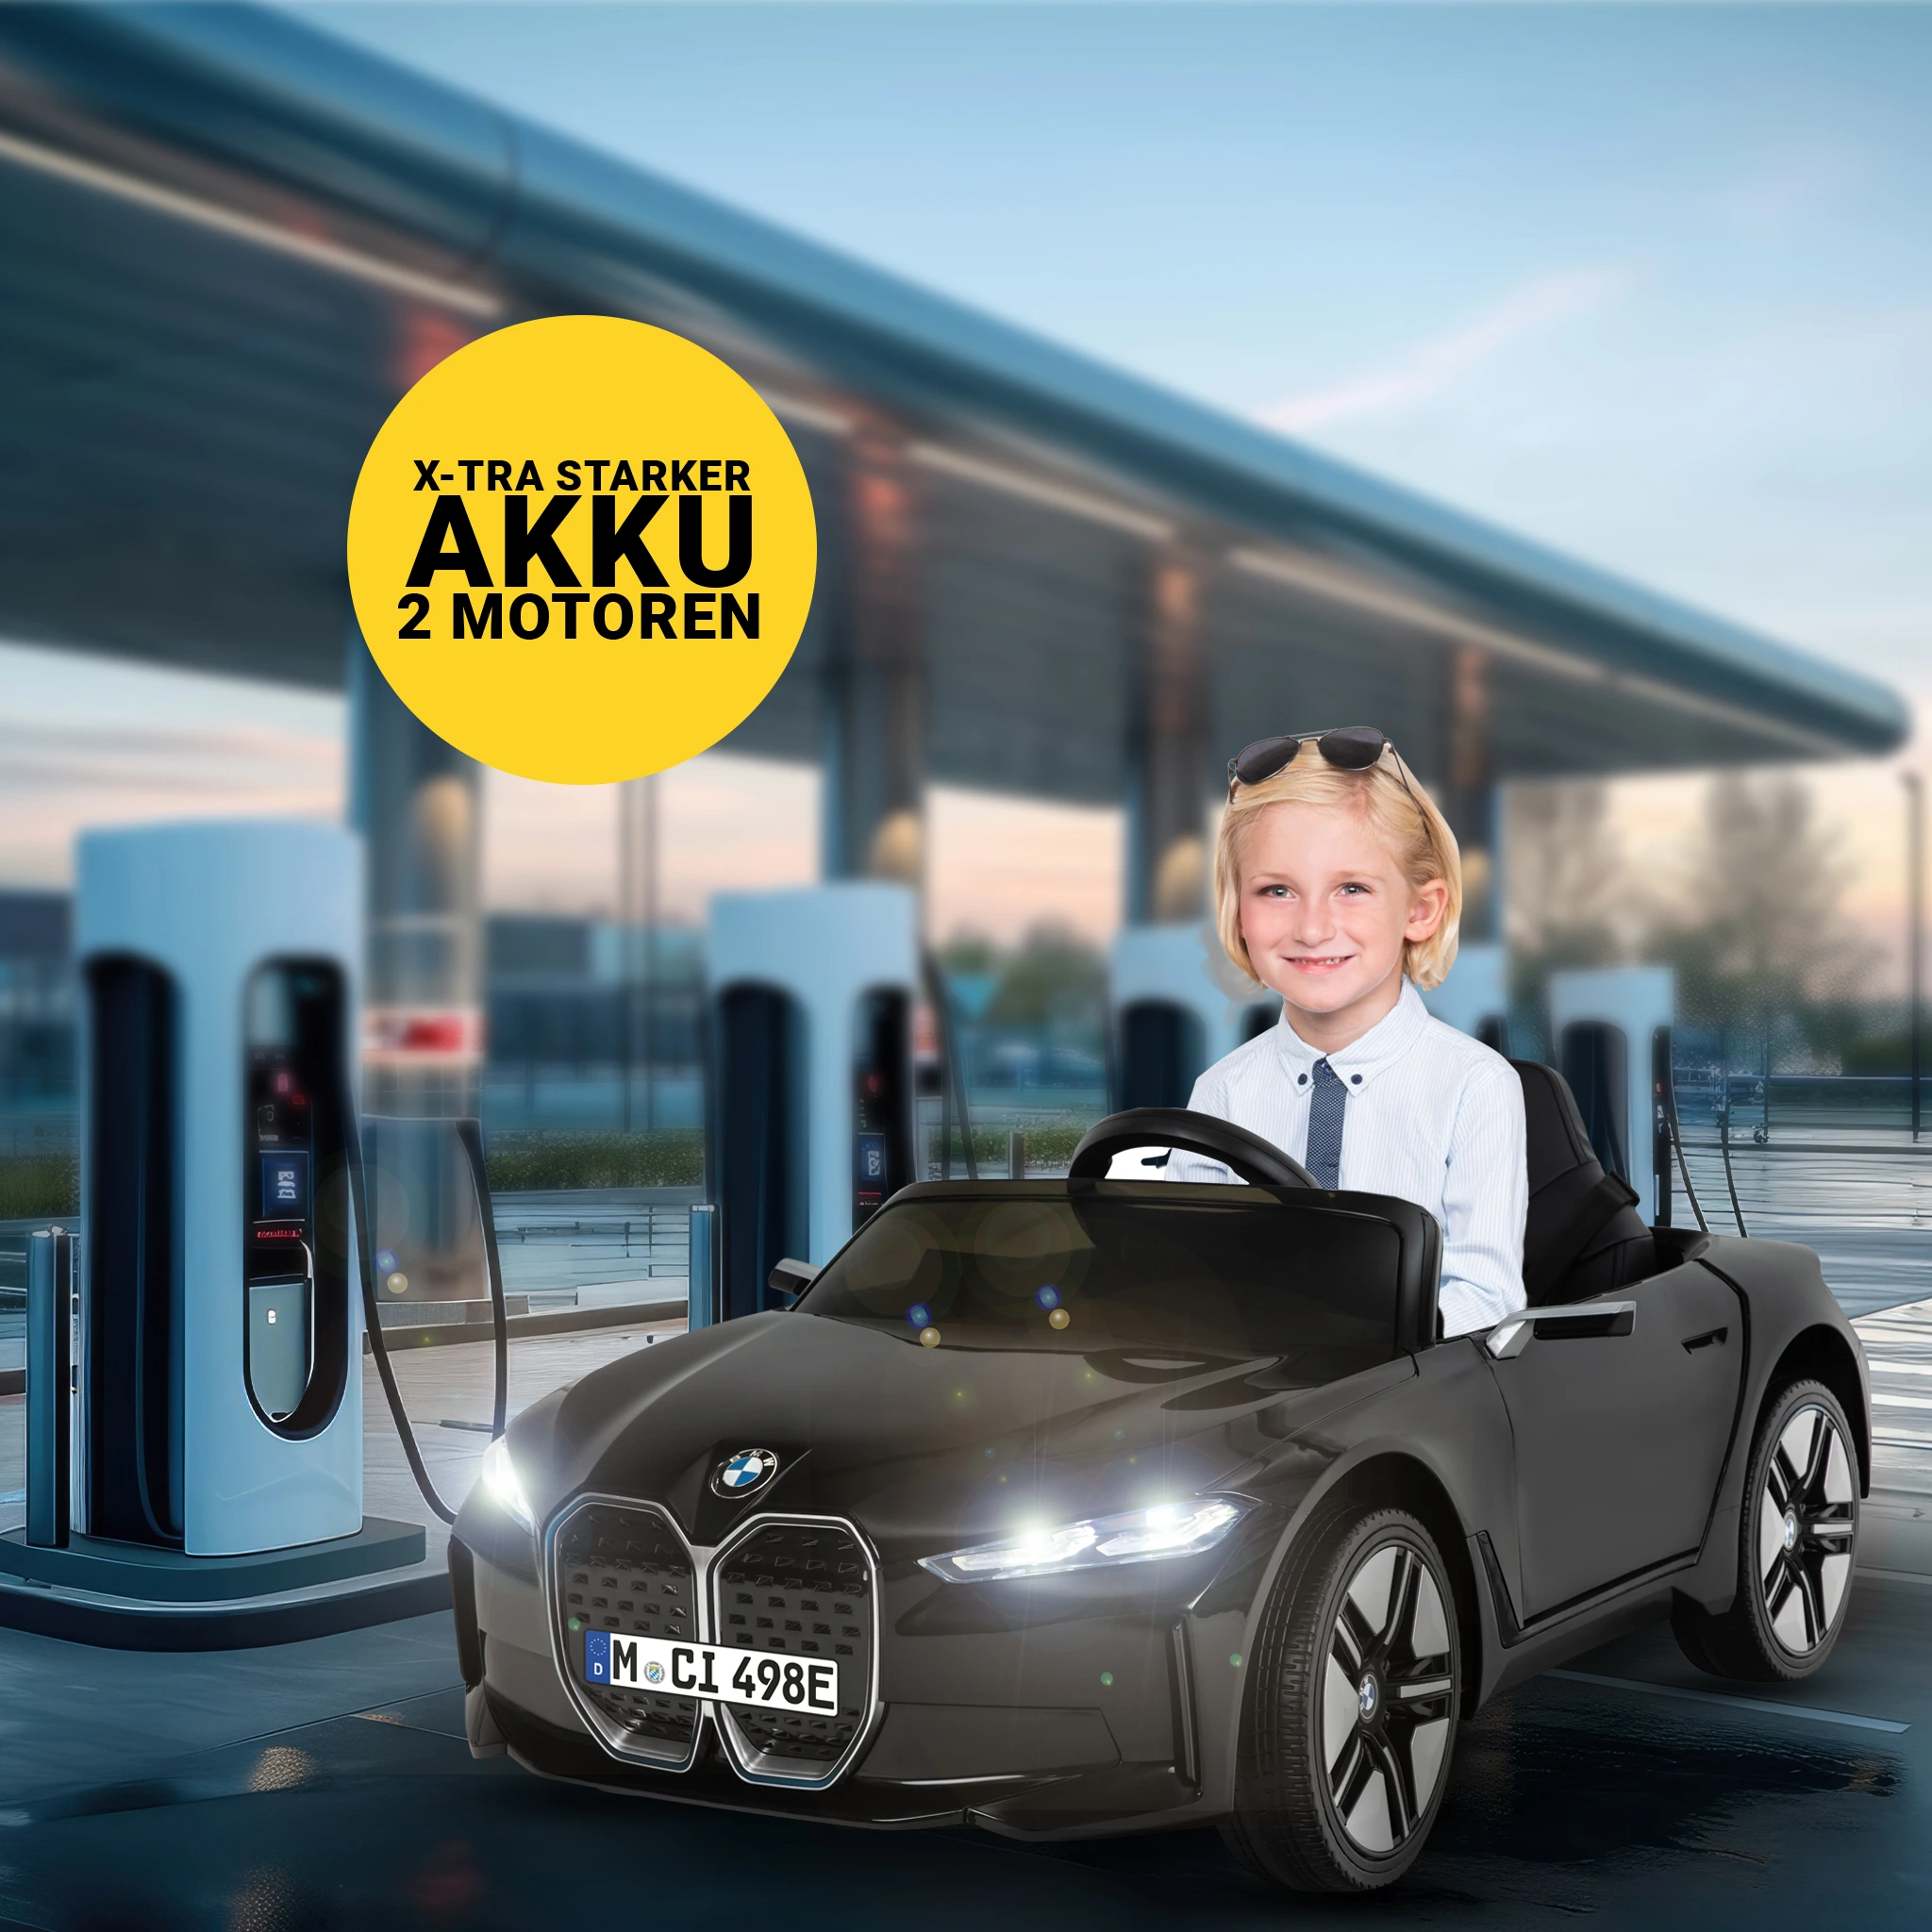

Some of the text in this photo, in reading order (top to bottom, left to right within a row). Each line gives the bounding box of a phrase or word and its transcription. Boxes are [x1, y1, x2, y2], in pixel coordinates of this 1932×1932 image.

[593, 1662, 603, 1675] D
[613, 1640, 637, 1682] M
[672, 1647, 718, 1693] CI
[732, 1656, 834, 1709] 498E
